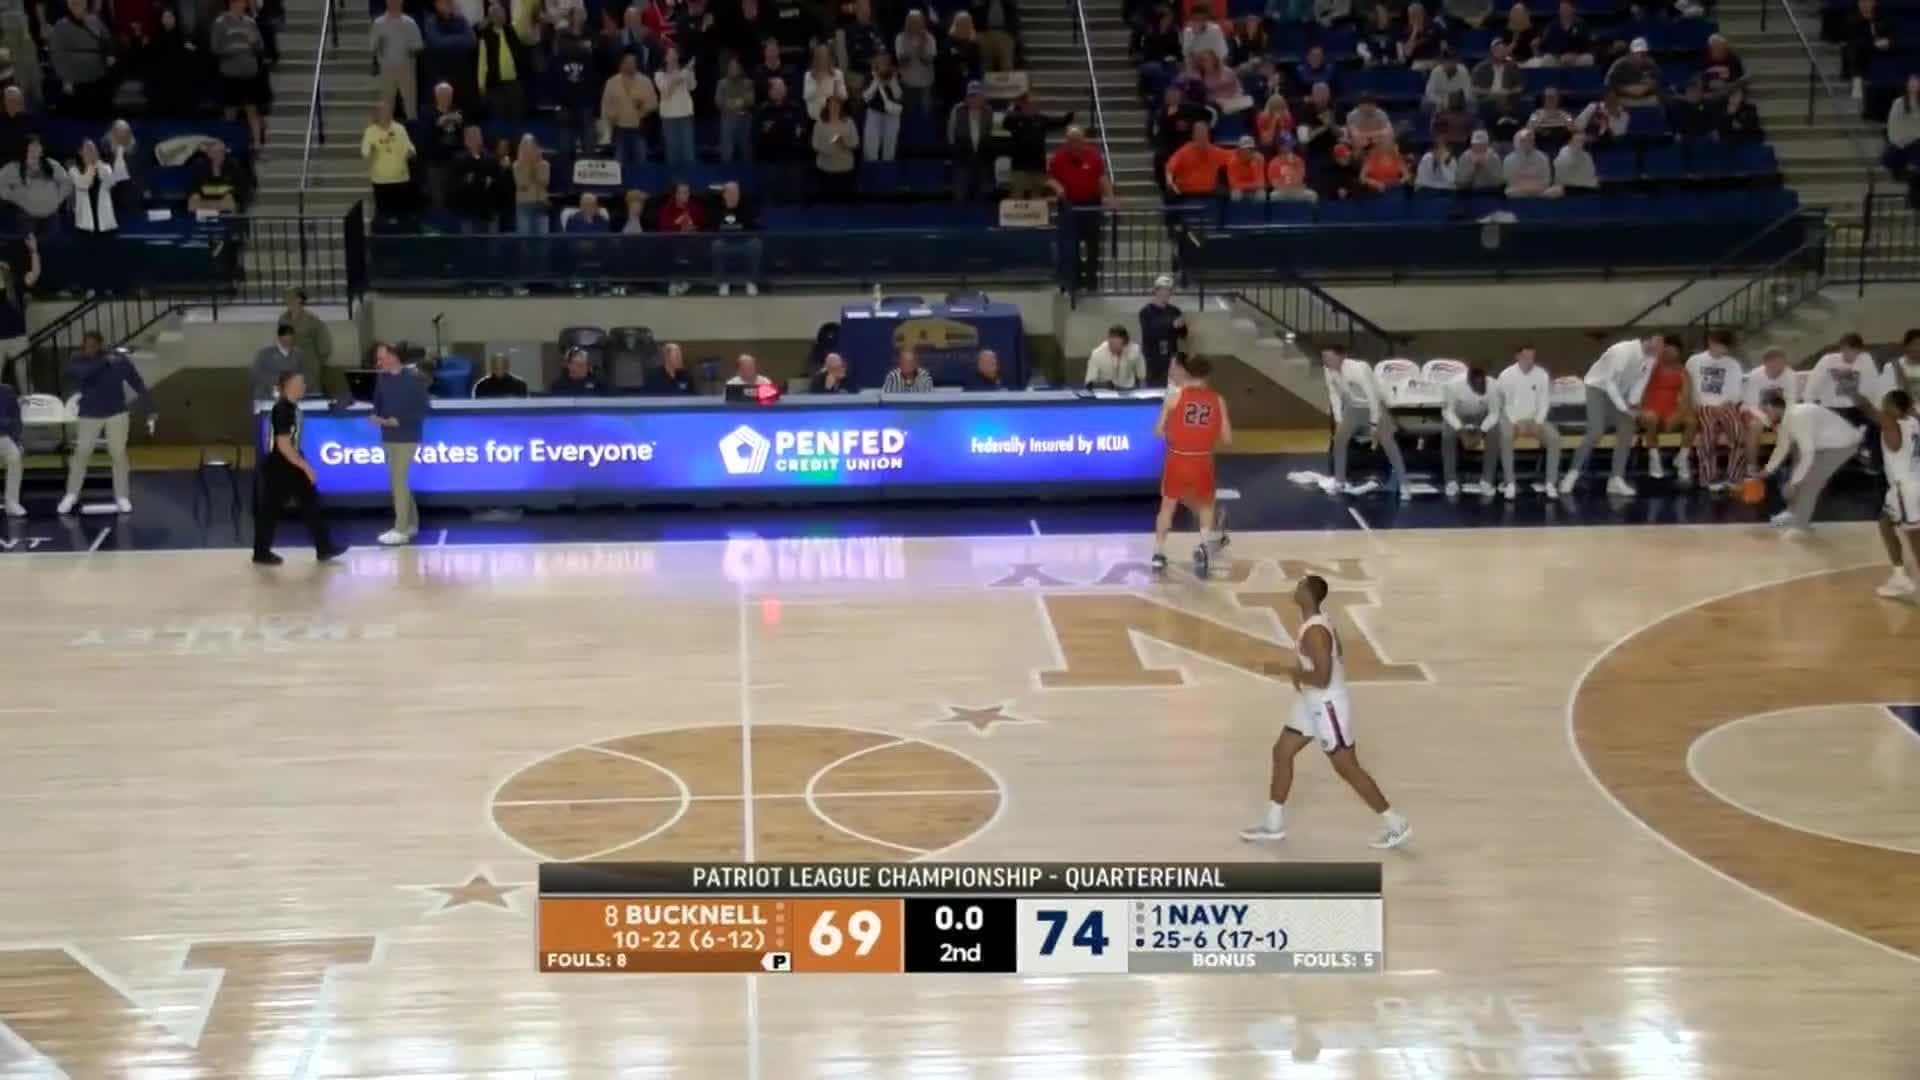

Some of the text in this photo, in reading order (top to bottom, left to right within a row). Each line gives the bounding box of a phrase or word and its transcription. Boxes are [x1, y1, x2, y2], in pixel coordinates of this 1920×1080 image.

[1184, 402, 1211, 425] 22
[776, 428, 904, 455] PENFED
[971, 436, 1130, 456] Federally Insured by NCUA
[320, 440, 653, 467] Grea ates for Everyone
[776, 458, 903, 472] CREDIT UNION
